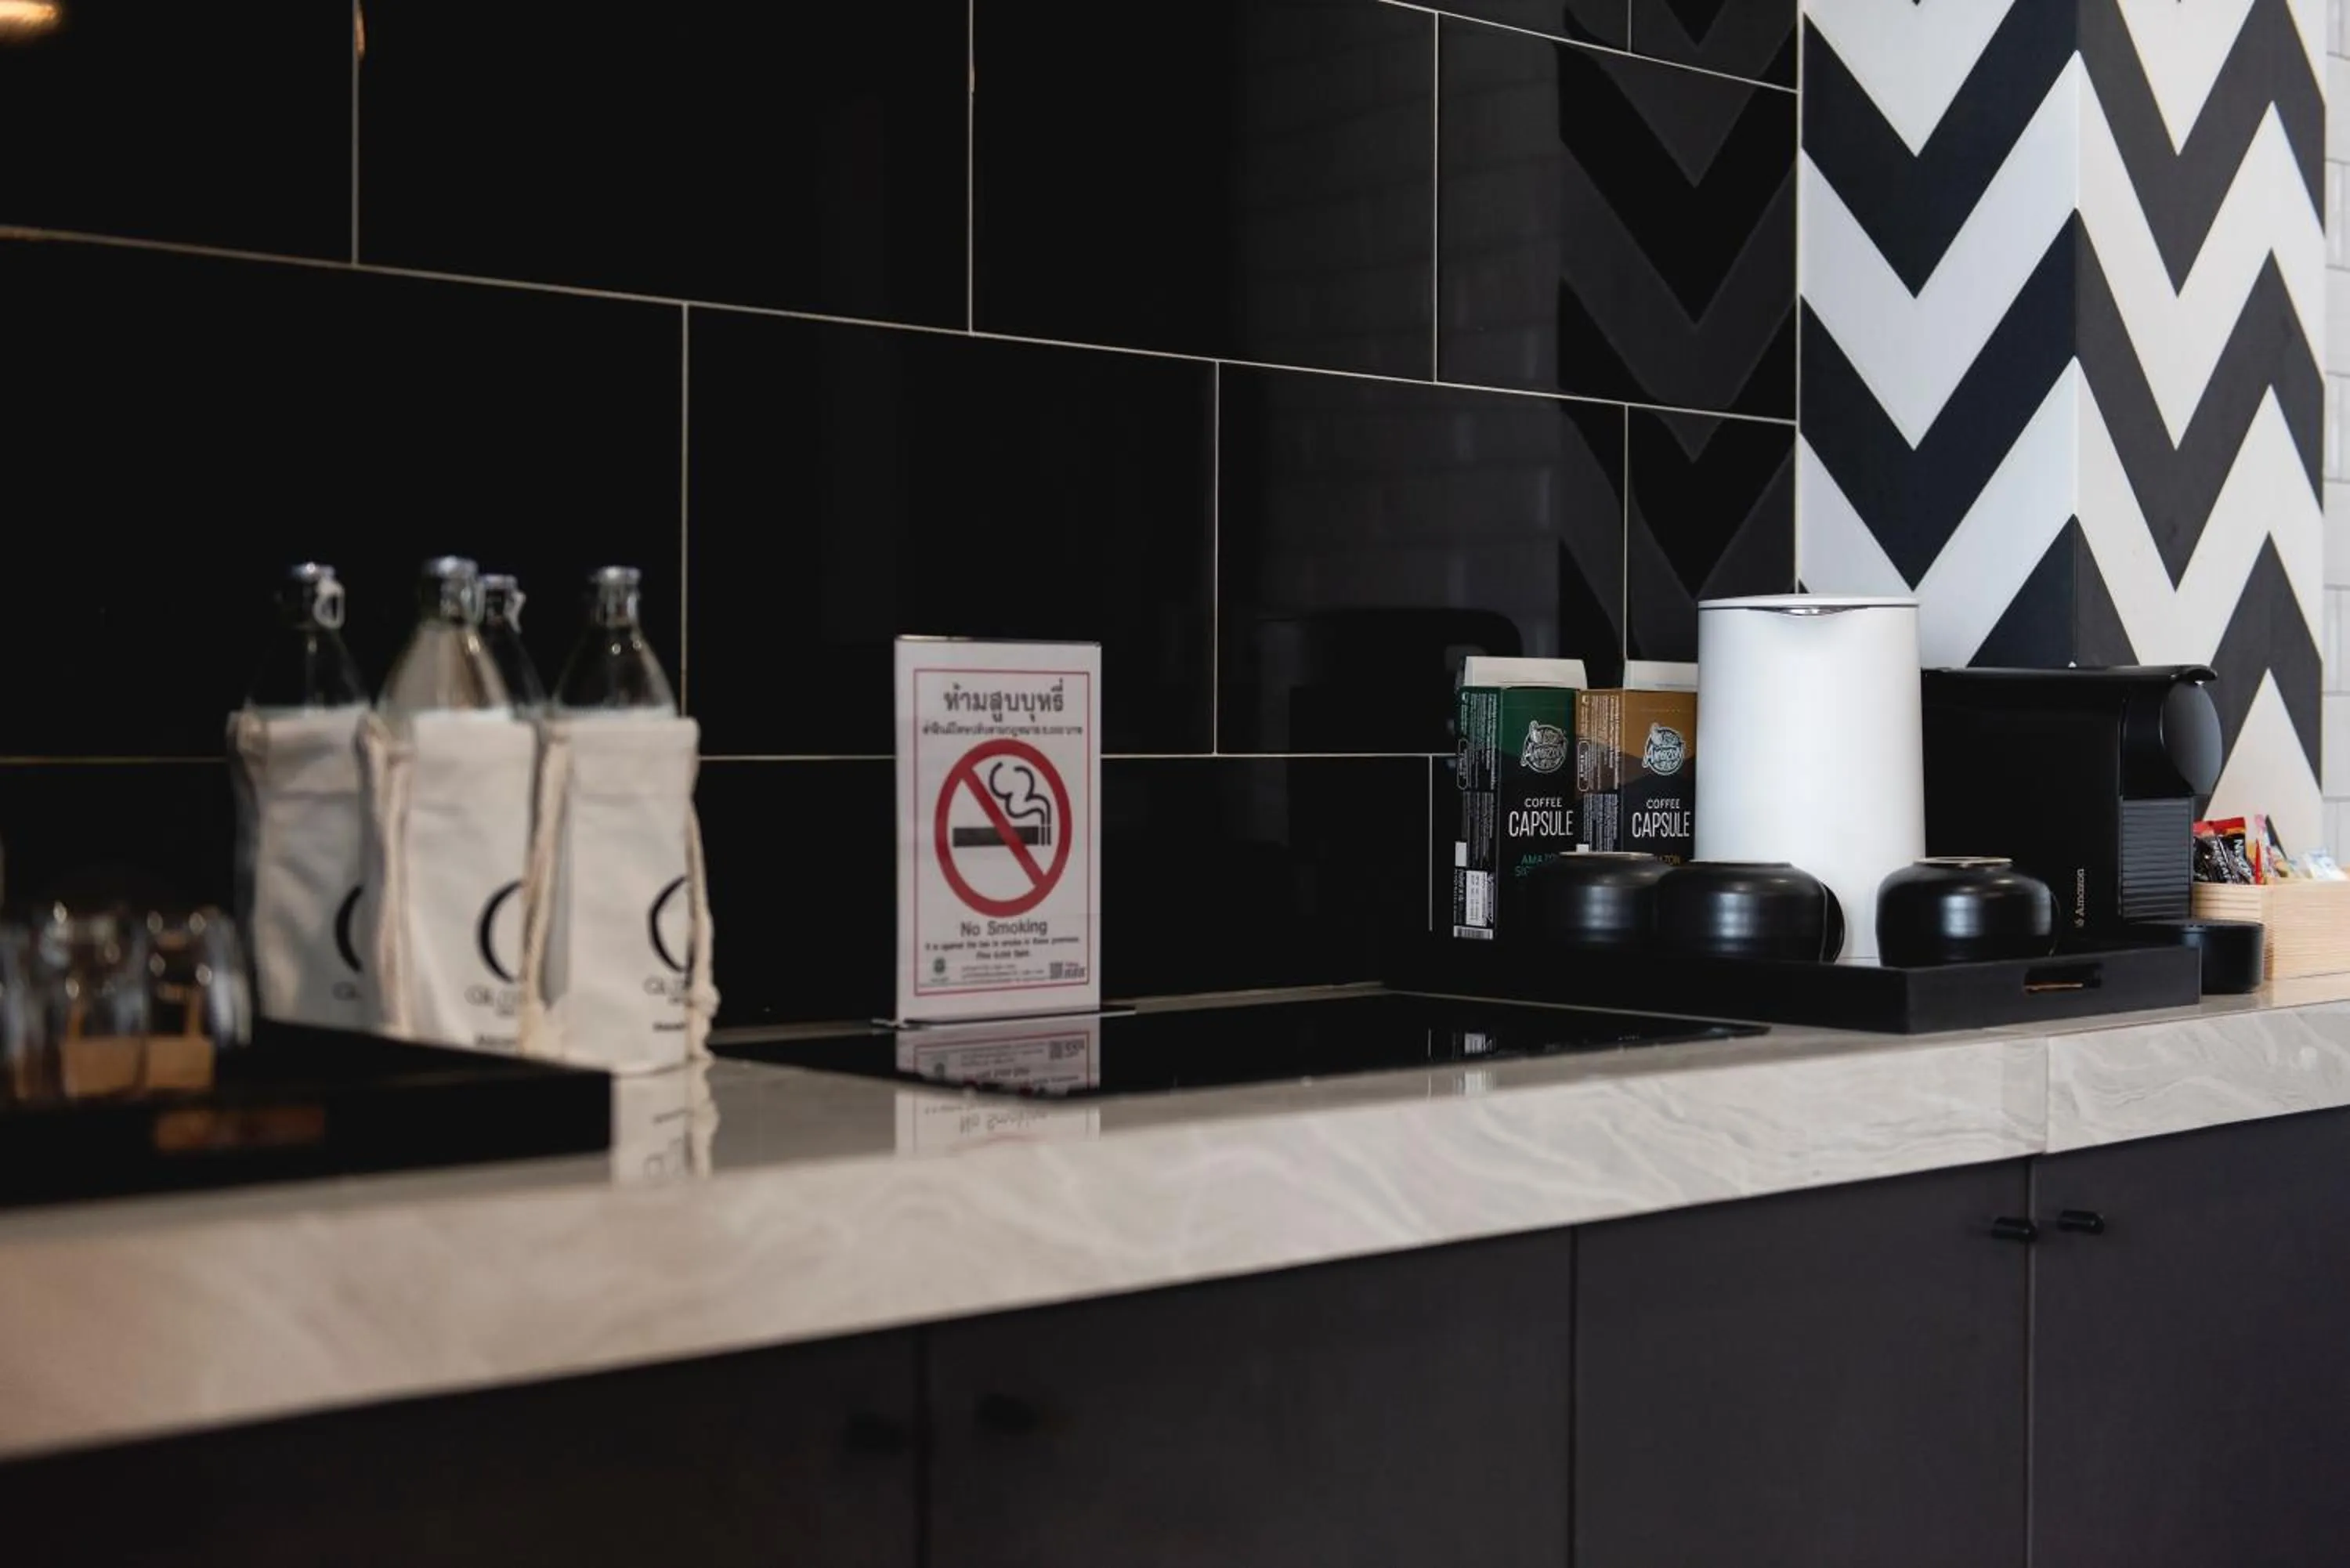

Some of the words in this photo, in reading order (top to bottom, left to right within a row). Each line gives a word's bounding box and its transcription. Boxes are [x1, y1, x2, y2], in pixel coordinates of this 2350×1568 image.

[1524, 797, 1563, 807] COFFEE
[1646, 798, 1680, 809] COFFEE
[1508, 810, 1574, 837] CAPSULE
[1632, 811, 1690, 838] CAPSULE
[960, 921, 981, 938] No
[987, 919, 1048, 936] Smoking
